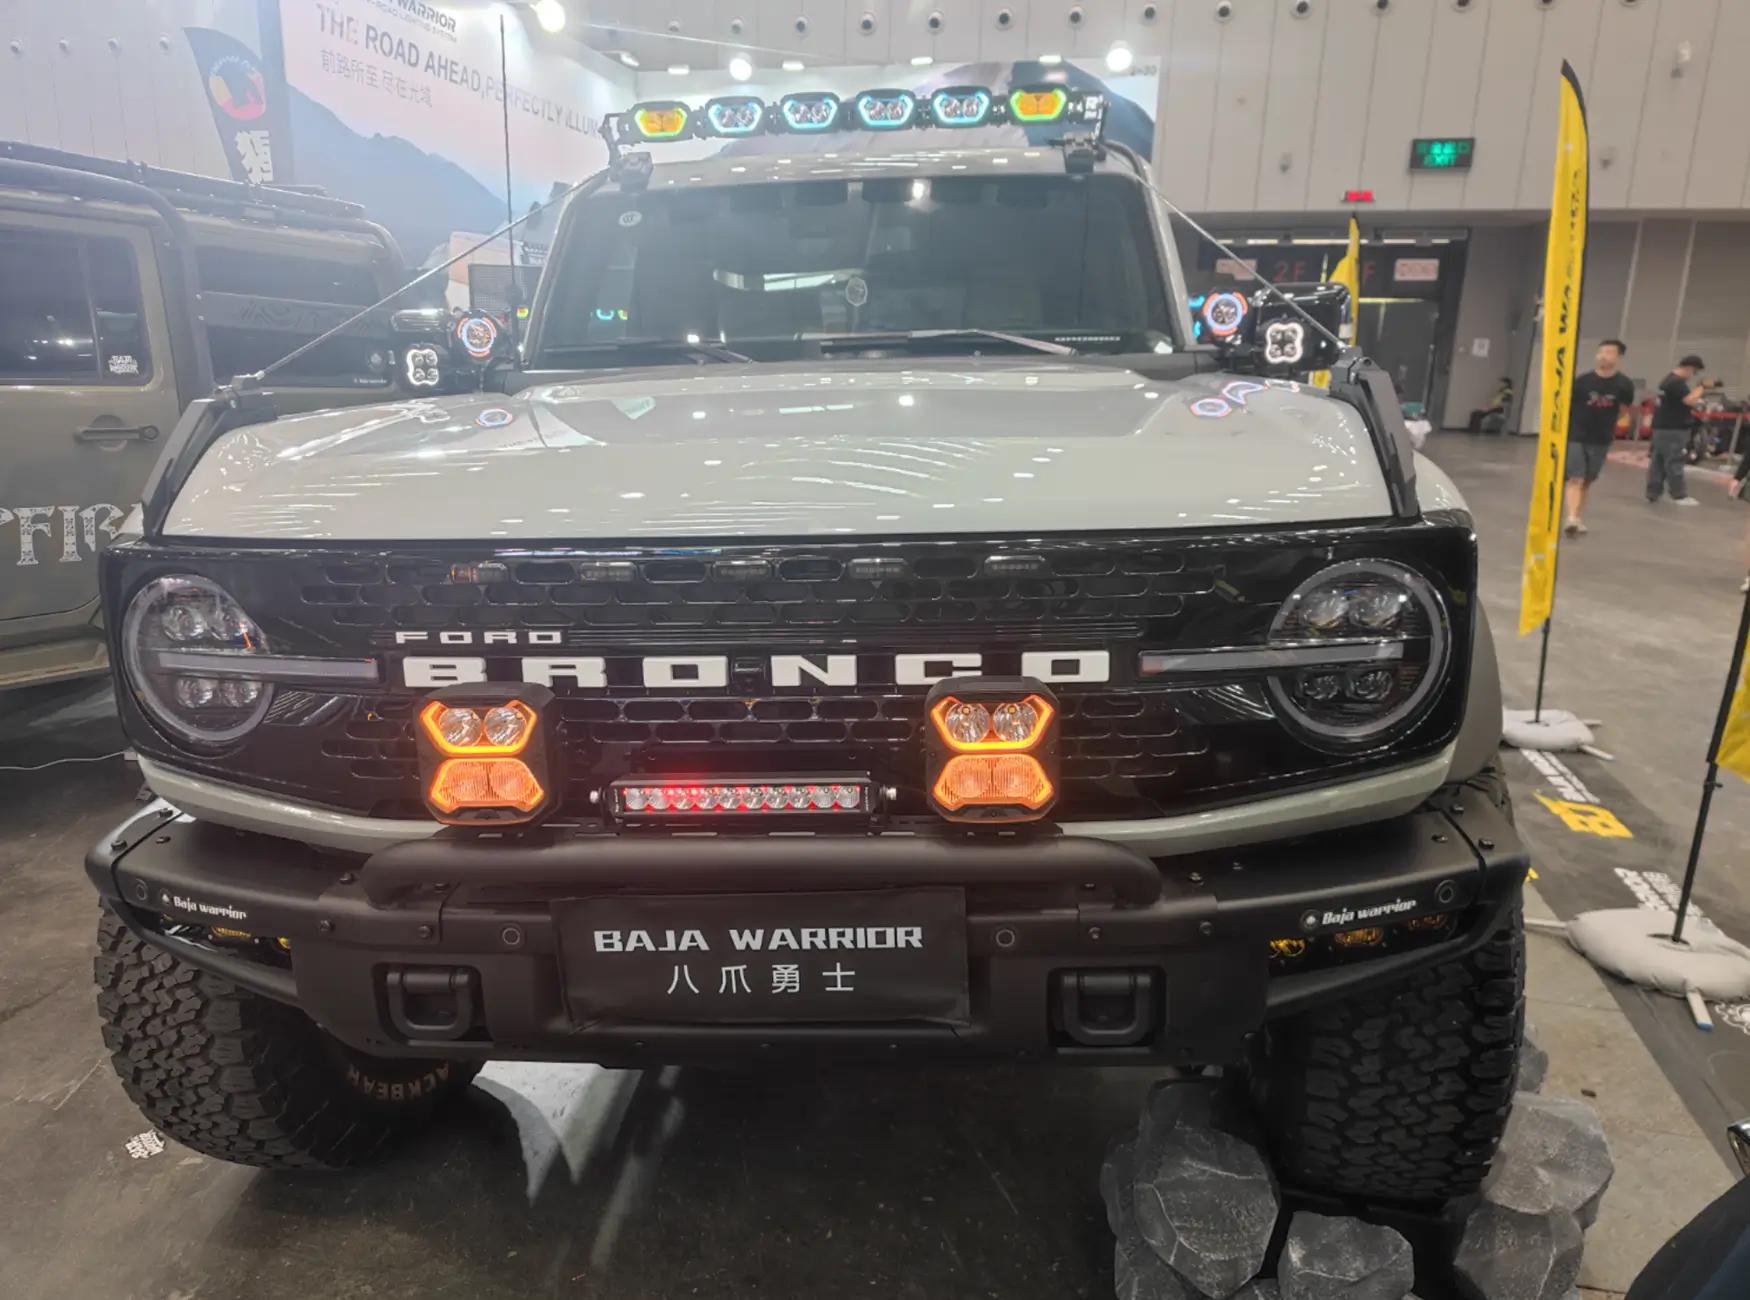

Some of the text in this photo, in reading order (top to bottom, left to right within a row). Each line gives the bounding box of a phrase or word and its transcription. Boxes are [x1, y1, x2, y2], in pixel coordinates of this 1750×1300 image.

[316, 3, 360, 46] THE
[365, 23, 420, 68] ROAD
[395, 631, 562, 644] FORD
[402, 650, 1110, 688] BRONCO
[173, 896, 247, 920] Baja warrior
[1322, 896, 1417, 925] Baja warrior
[593, 926, 923, 952] BAJA WARRIOR
[667, 962, 856, 994] 八爪勇士
